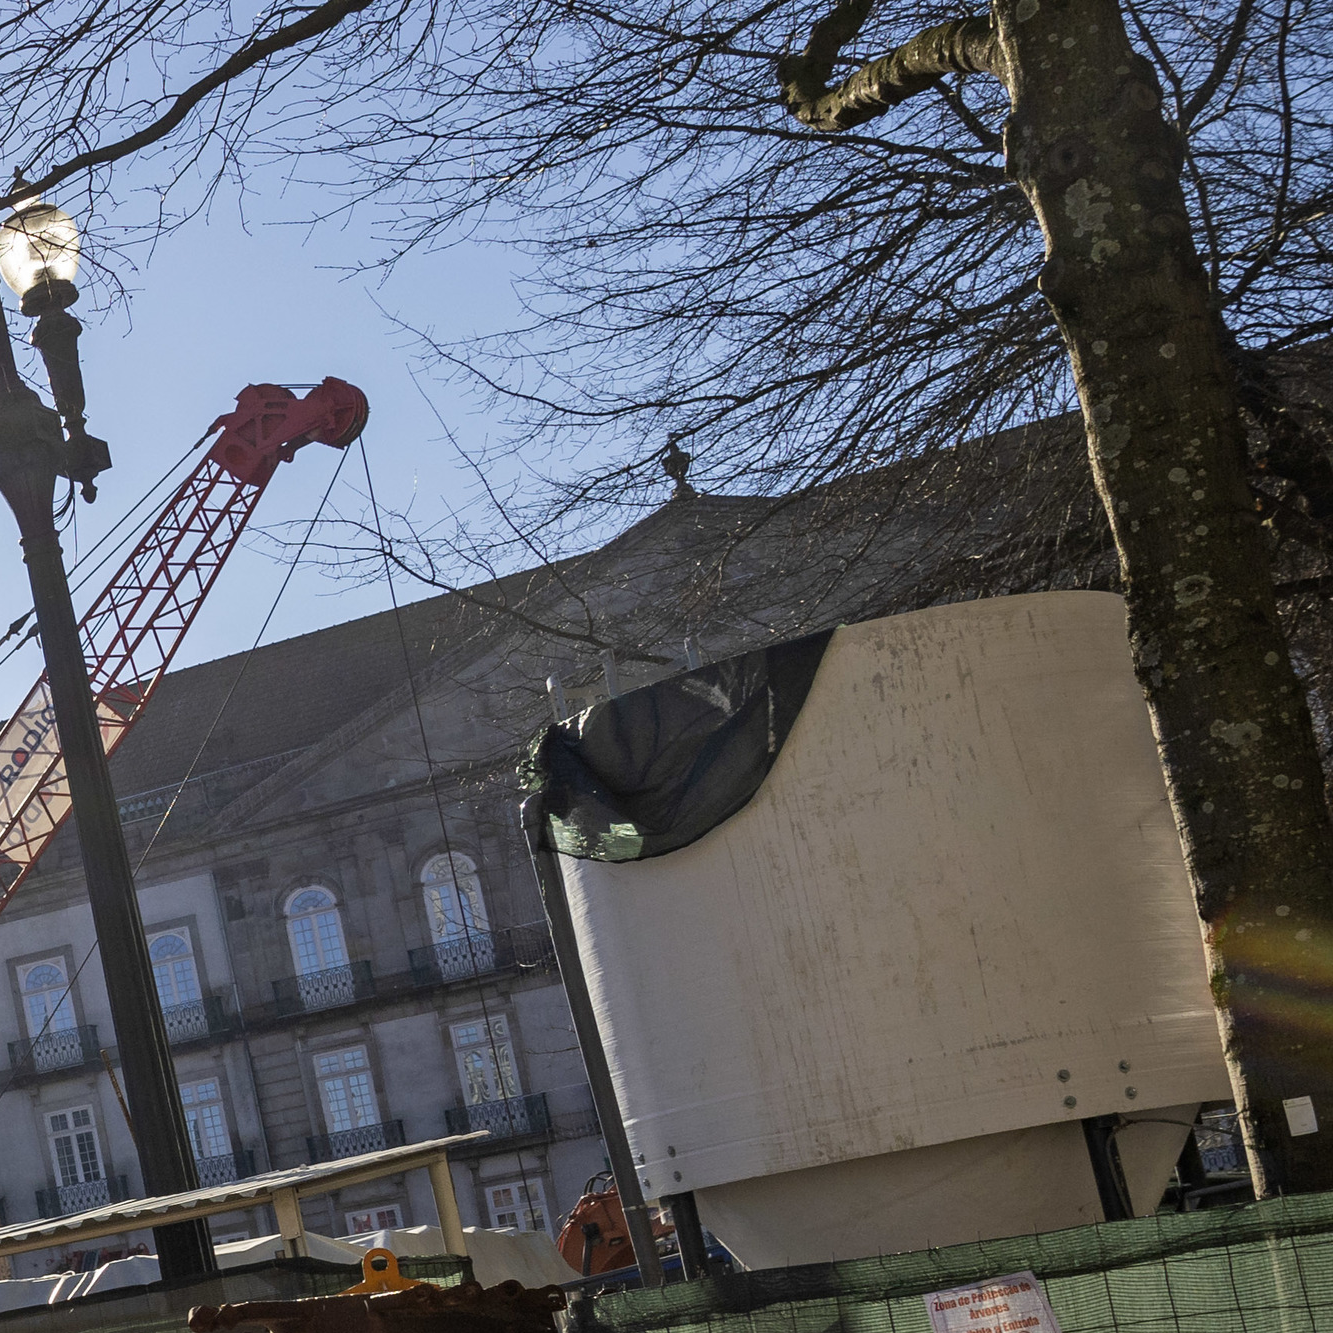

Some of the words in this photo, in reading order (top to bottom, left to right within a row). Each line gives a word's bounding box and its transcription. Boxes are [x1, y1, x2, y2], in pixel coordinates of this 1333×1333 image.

[934, 1300, 957, 1312] Zona
[958, 1295, 970, 1307] de
[1019, 1281, 1031, 1292] de
[994, 1326, 1001, 1333] a
[1002, 1316, 1040, 1332] Entrada
